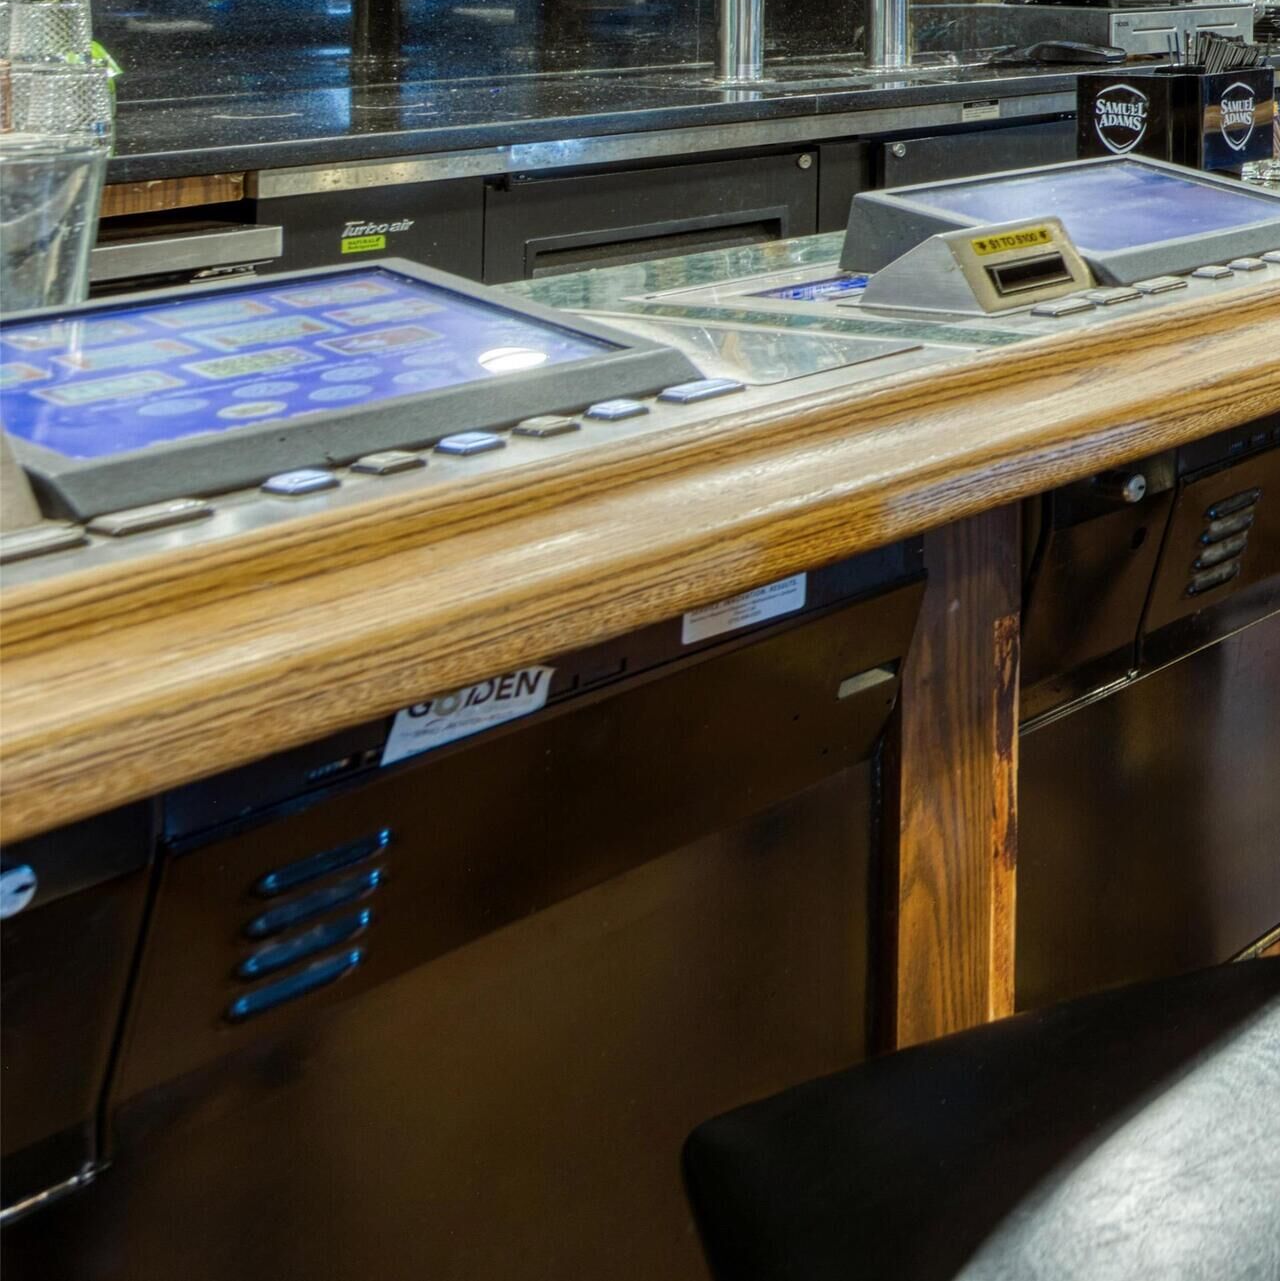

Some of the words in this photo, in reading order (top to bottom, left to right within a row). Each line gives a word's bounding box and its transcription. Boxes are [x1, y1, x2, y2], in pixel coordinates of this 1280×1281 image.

[1096, 99, 1148, 118] SAMUEL
[1220, 97, 1256, 115] SAMUEL
[1099, 114, 1142, 131] ADAMS
[1223, 111, 1253, 128] ADAMS
[341, 220, 389, 238] Turbo
[388, 218, 415, 233] air
[1000, 236, 1016, 247] TO
